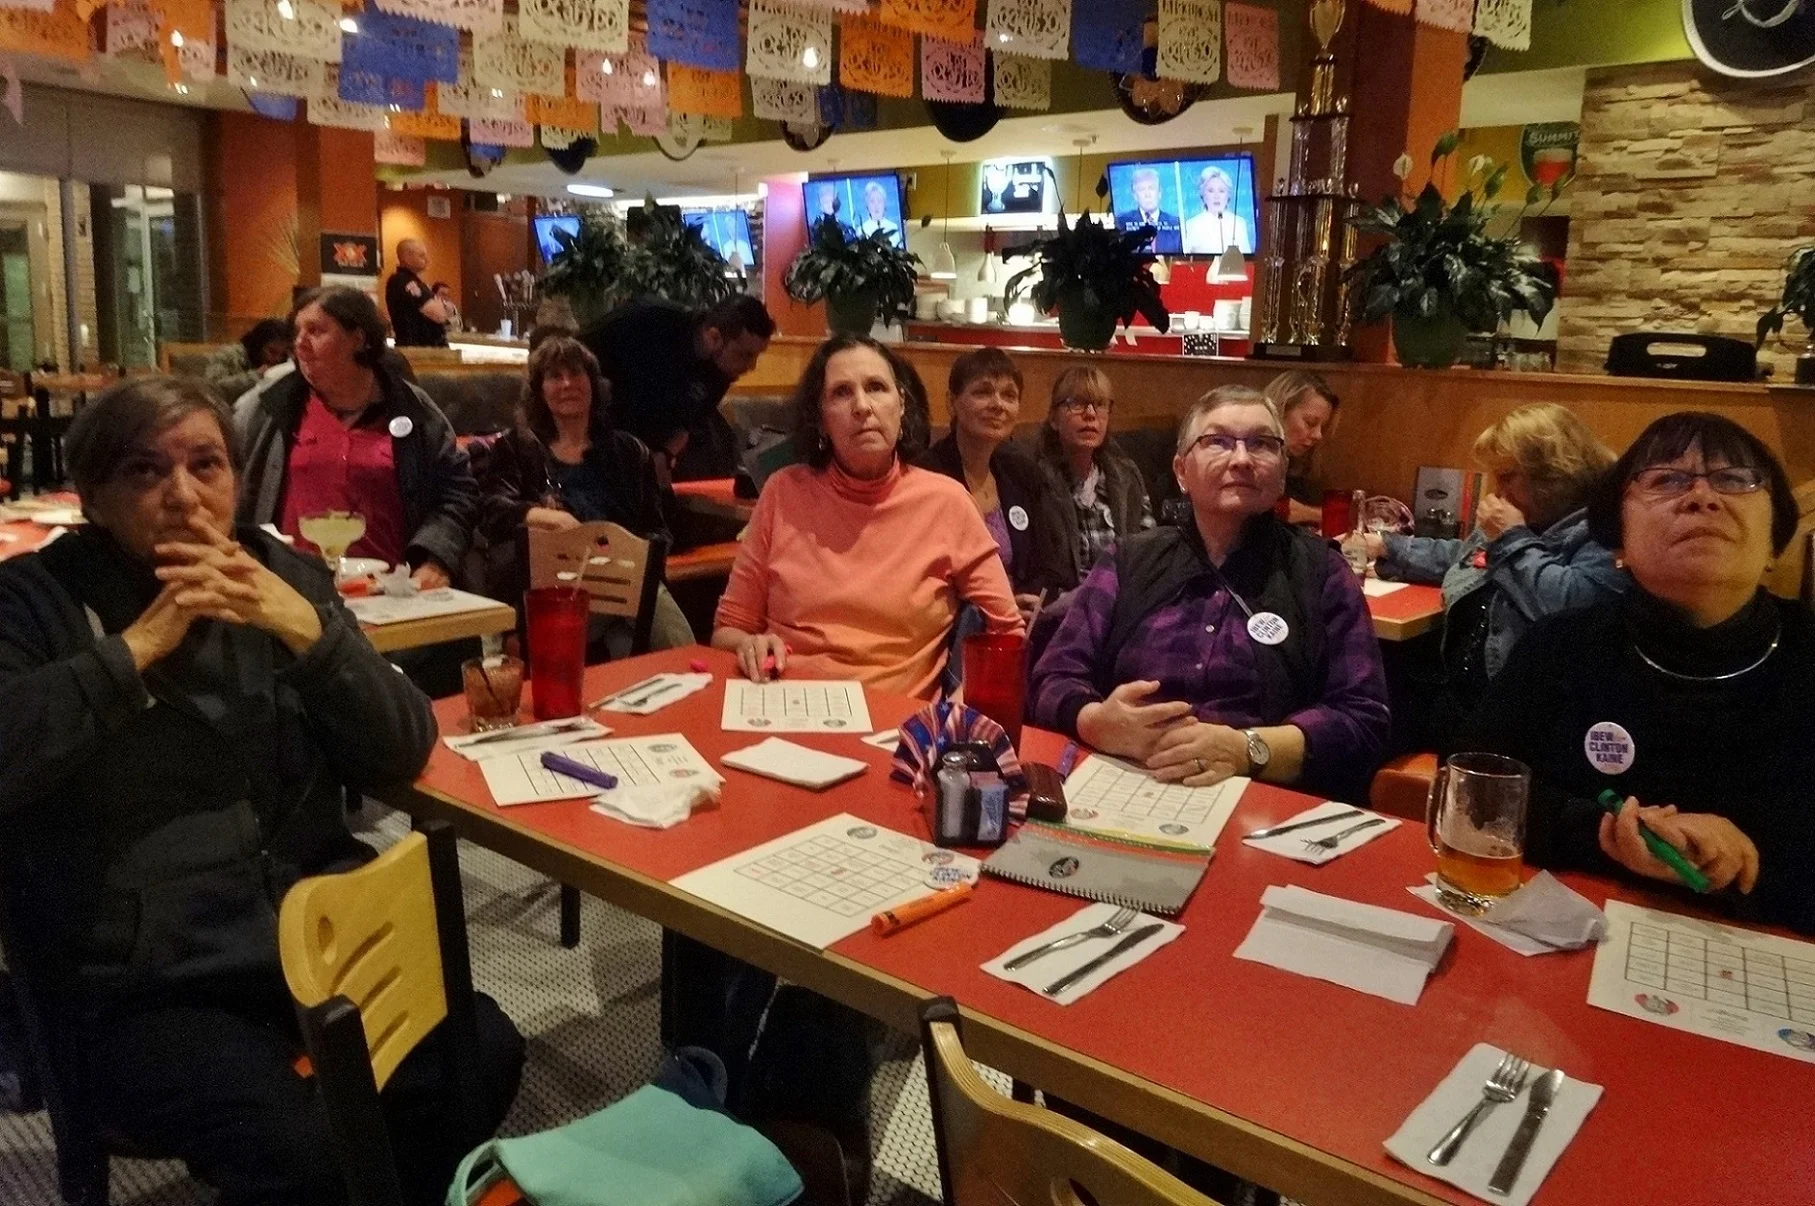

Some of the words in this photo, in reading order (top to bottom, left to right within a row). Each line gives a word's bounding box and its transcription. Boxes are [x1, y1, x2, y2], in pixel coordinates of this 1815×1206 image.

[1257, 616, 1279, 638] CLINTON
[1590, 731, 1614, 742] IBEW
[1588, 742, 1628, 754] CLINTON
[1596, 753, 1624, 764] KAINE
